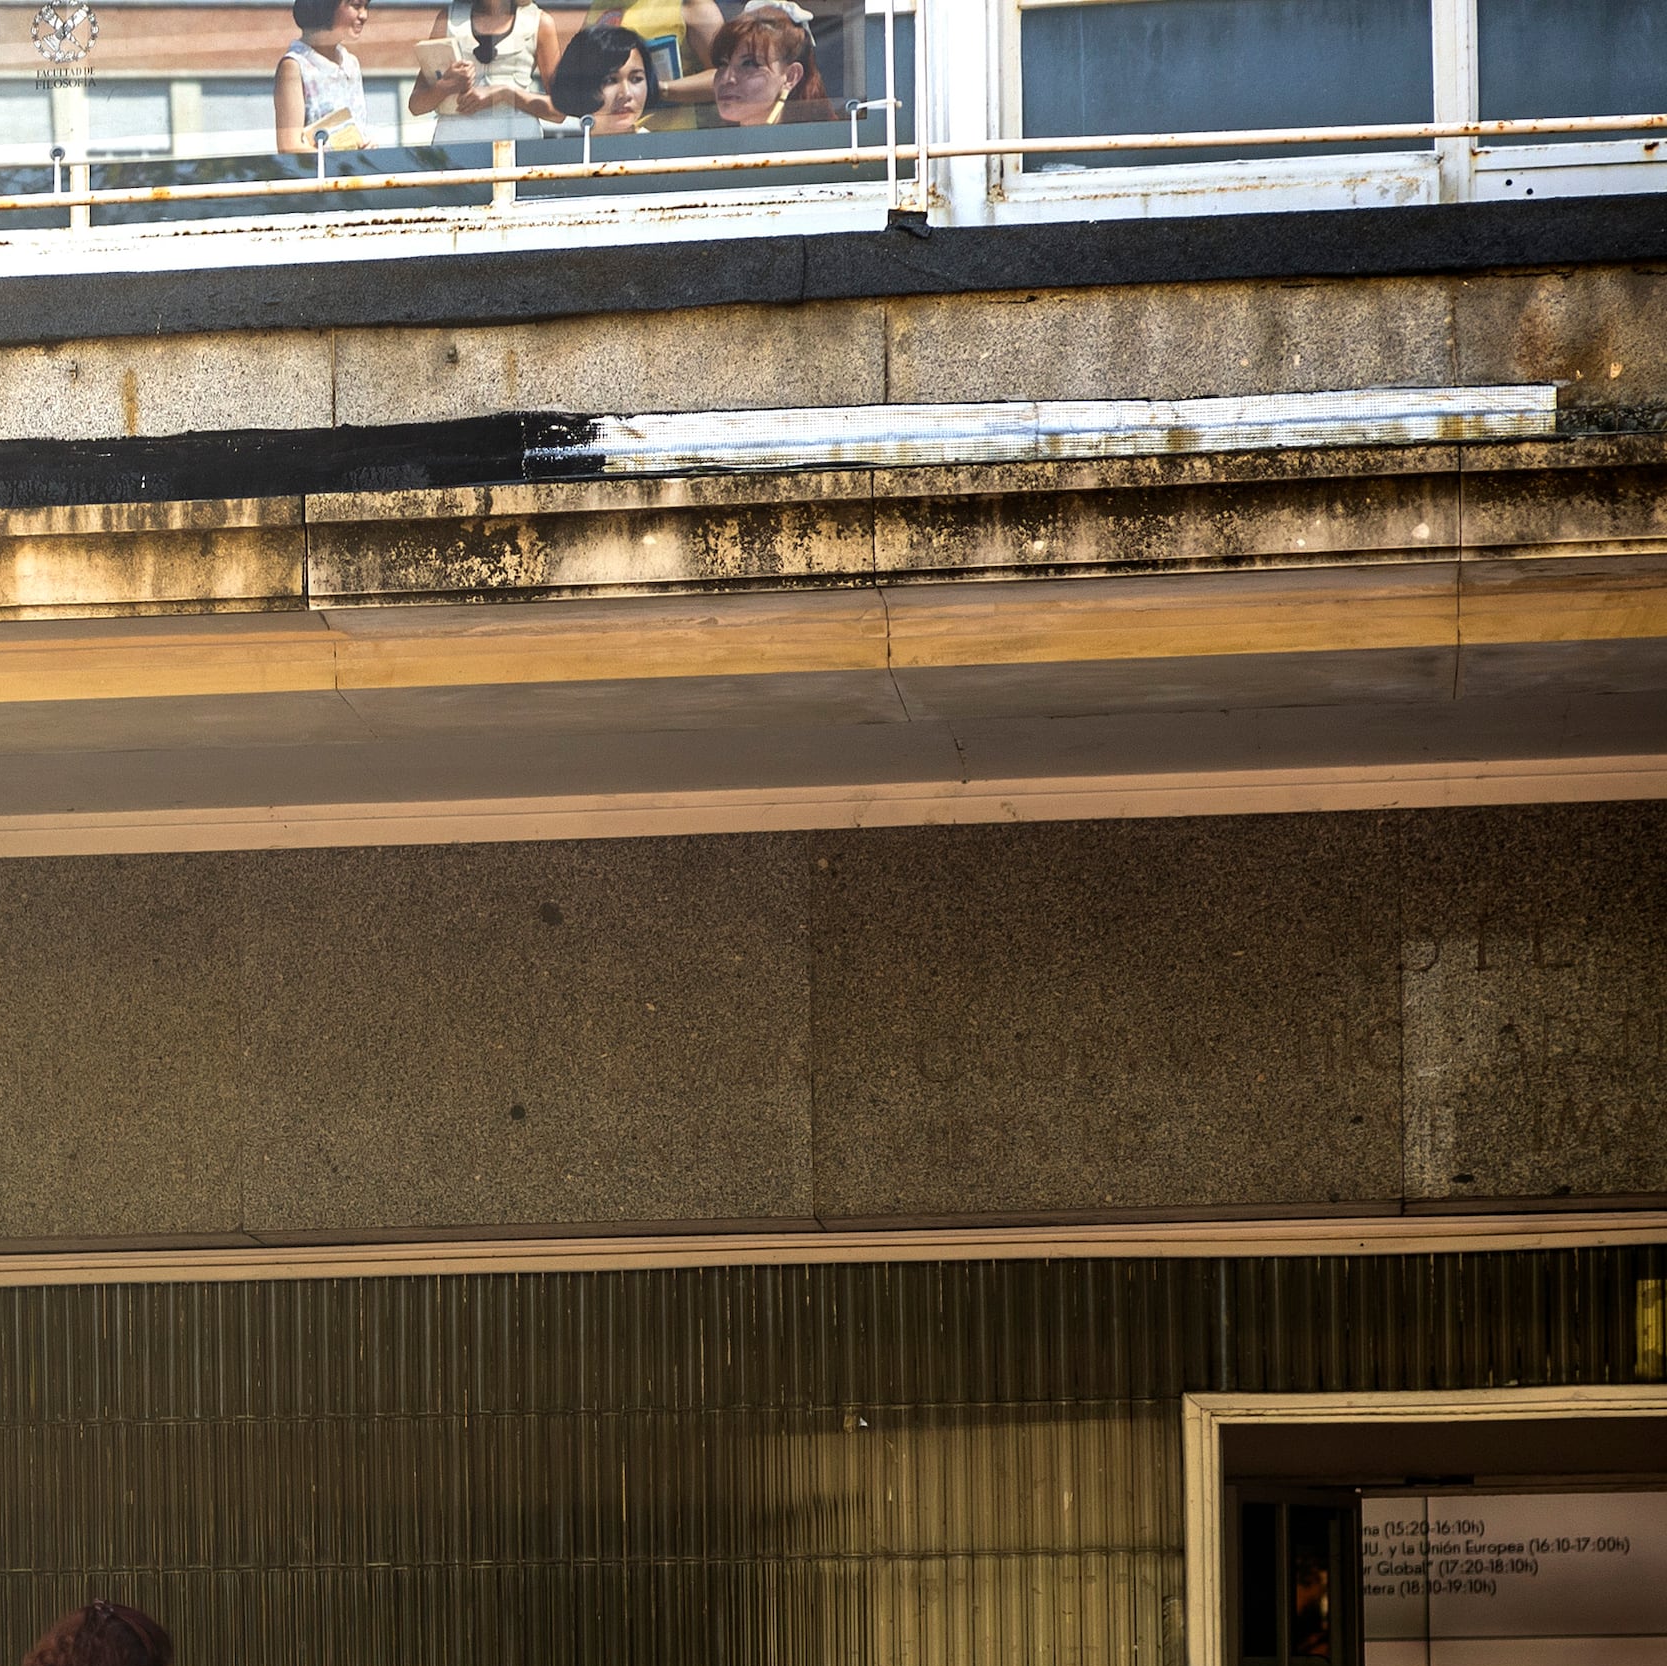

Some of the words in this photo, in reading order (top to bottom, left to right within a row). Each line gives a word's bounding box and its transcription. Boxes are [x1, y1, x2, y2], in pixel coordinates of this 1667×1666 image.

[36, 67, 82, 79] FACULTAD
[35, 75, 97, 91] FILOSOFÍA
[1389, 1545, 1397, 1558] y
[1402, 1541, 1415, 1556] la
[1420, 1539, 1461, 1555] Unión
[1467, 1540, 1524, 1556] Europea
